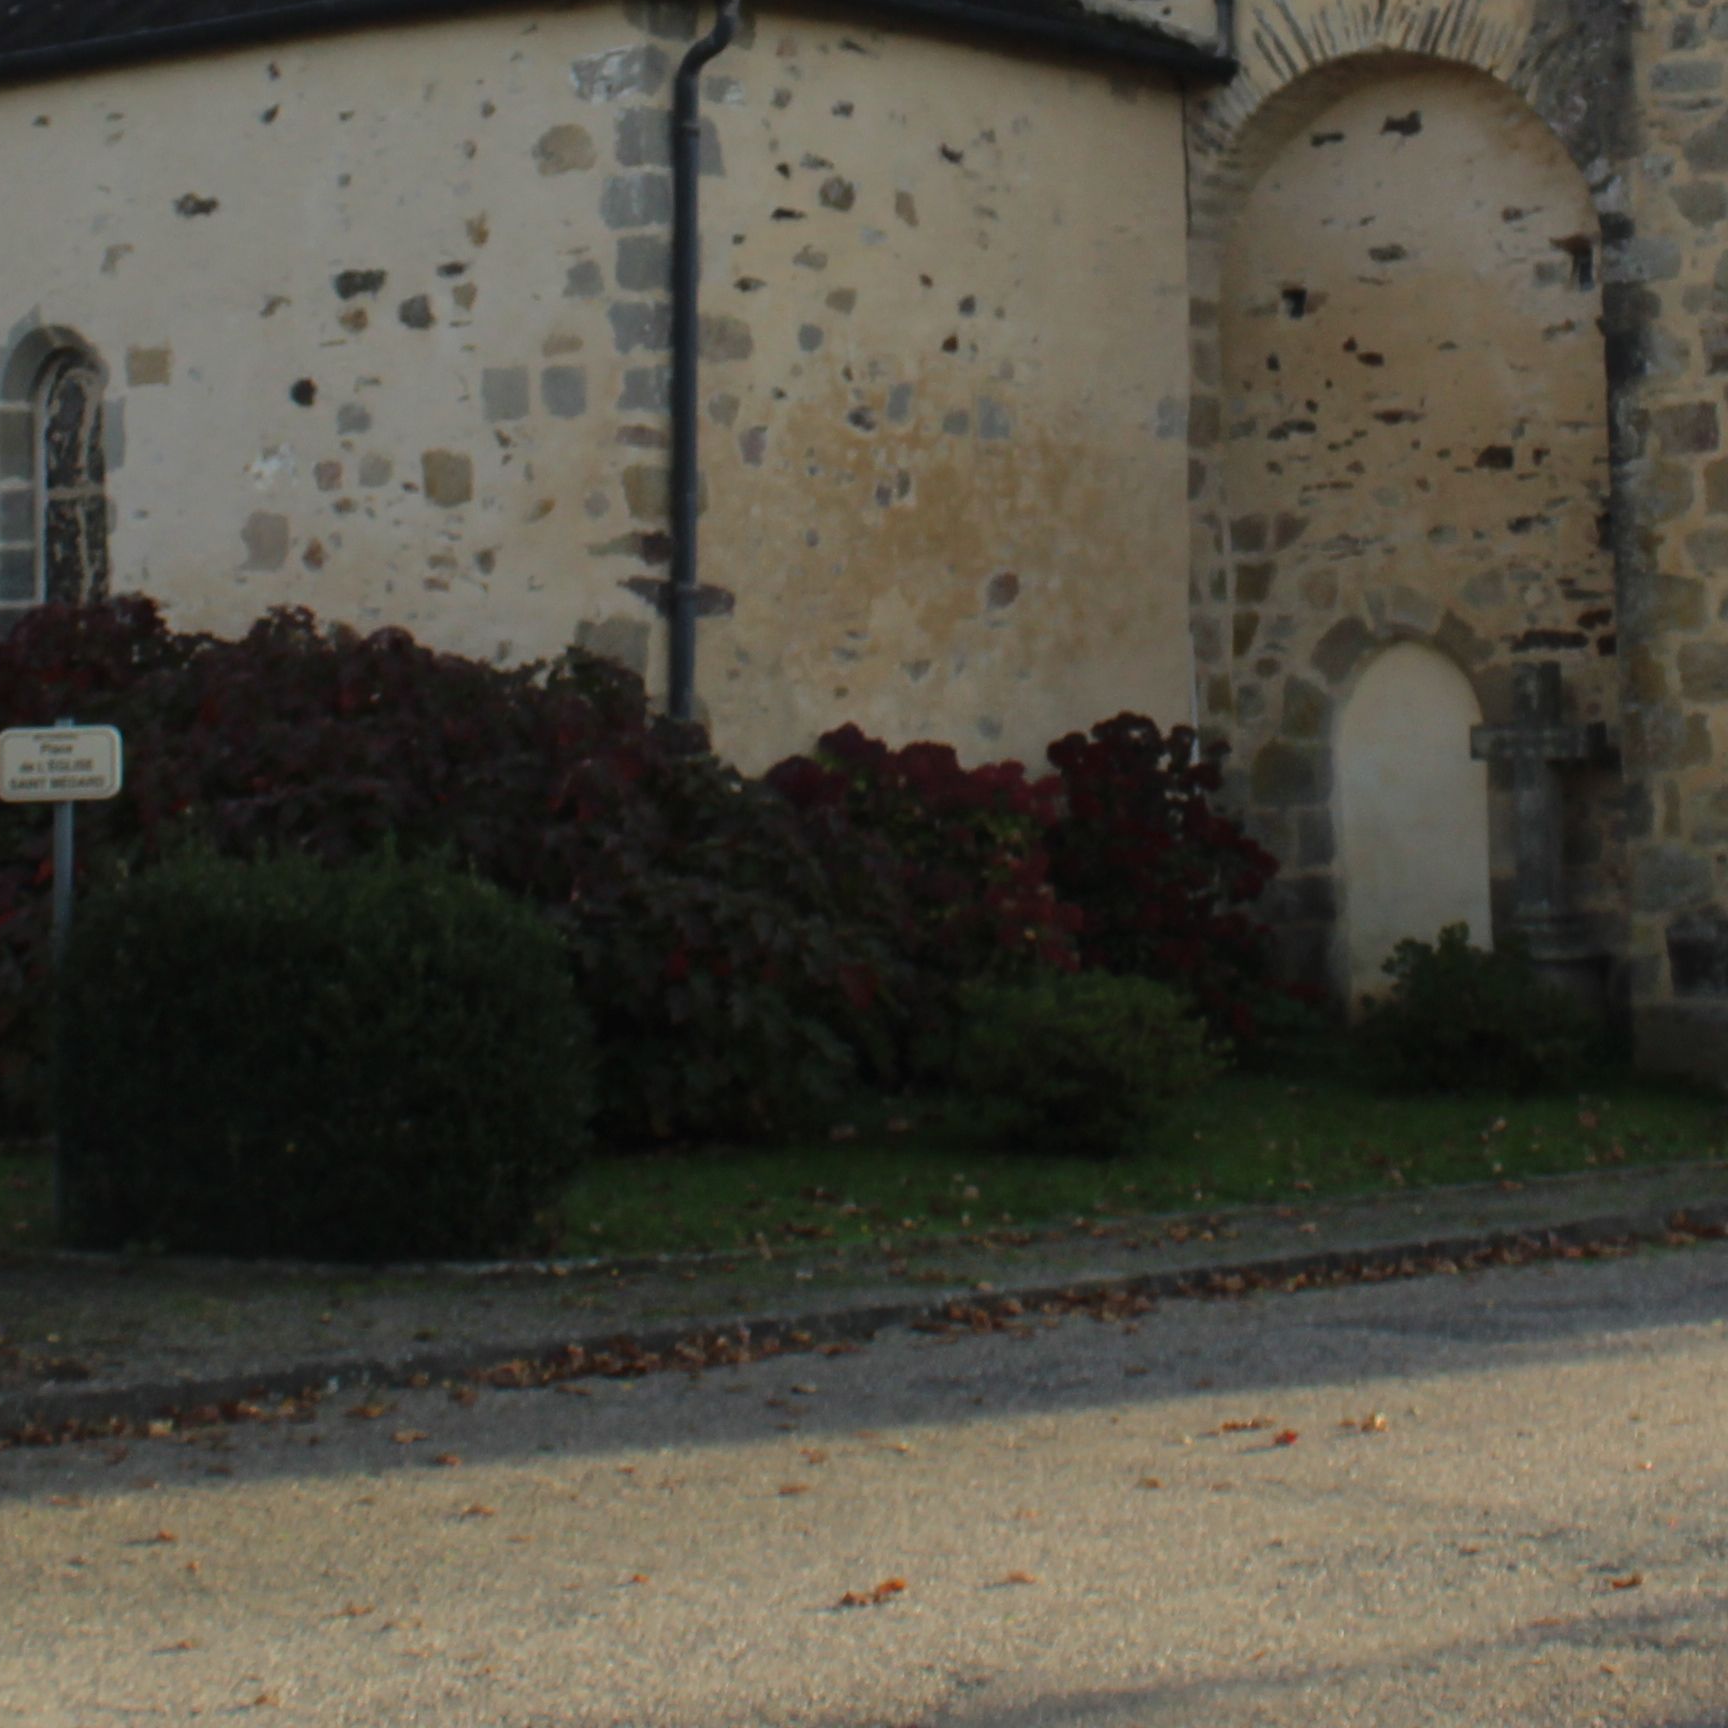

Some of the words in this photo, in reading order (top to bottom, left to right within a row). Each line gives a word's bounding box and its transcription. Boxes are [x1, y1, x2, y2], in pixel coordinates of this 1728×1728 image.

[40, 743, 73, 754] Place
[20, 759, 34, 771] de
[10, 775, 47, 789] SAINT
